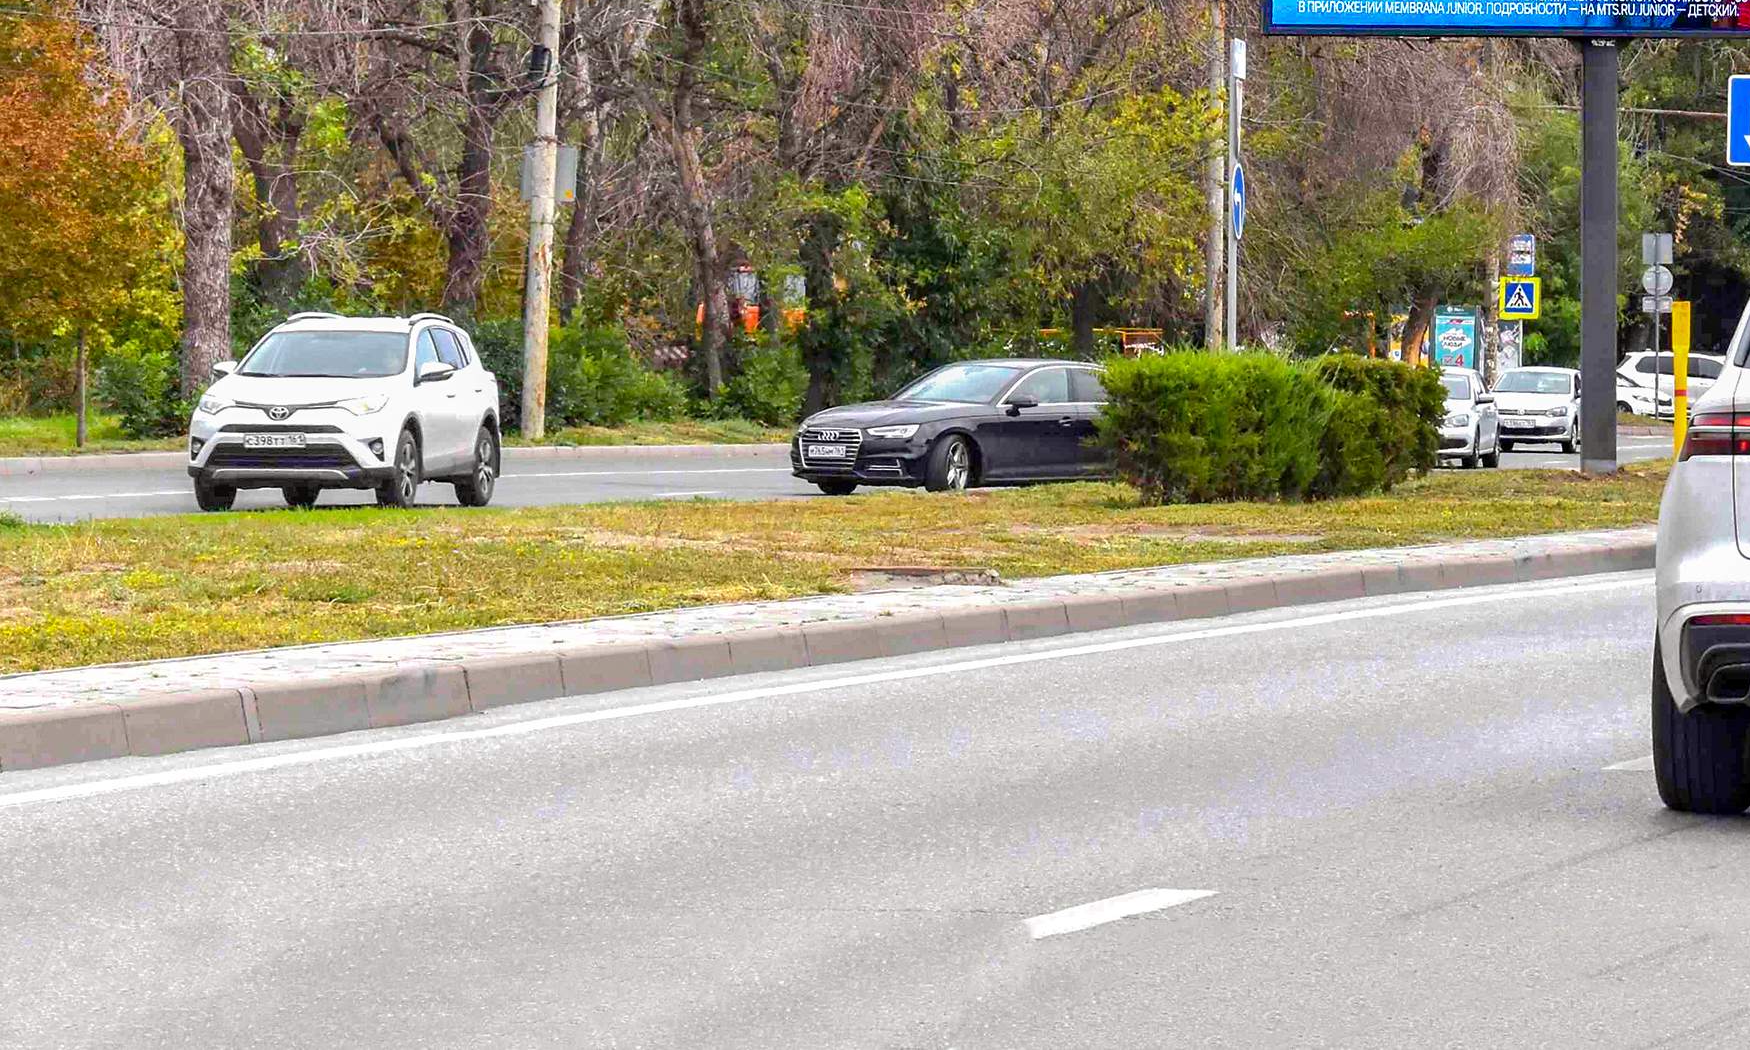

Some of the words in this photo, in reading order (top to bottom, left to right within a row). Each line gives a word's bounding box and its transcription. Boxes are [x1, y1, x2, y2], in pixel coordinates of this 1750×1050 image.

[1298, 1, 1306, 13] В
[1308, 1, 1383, 14] ПРИЛОЖЕНИИ
[1385, 2, 1445, 14] MEMBRANA
[1486, 3, 1567, 17] ПОДРОБНОСТИ
[1580, 3, 1596, 16] НА
[1639, 4, 1675, 16] JUNIOR
